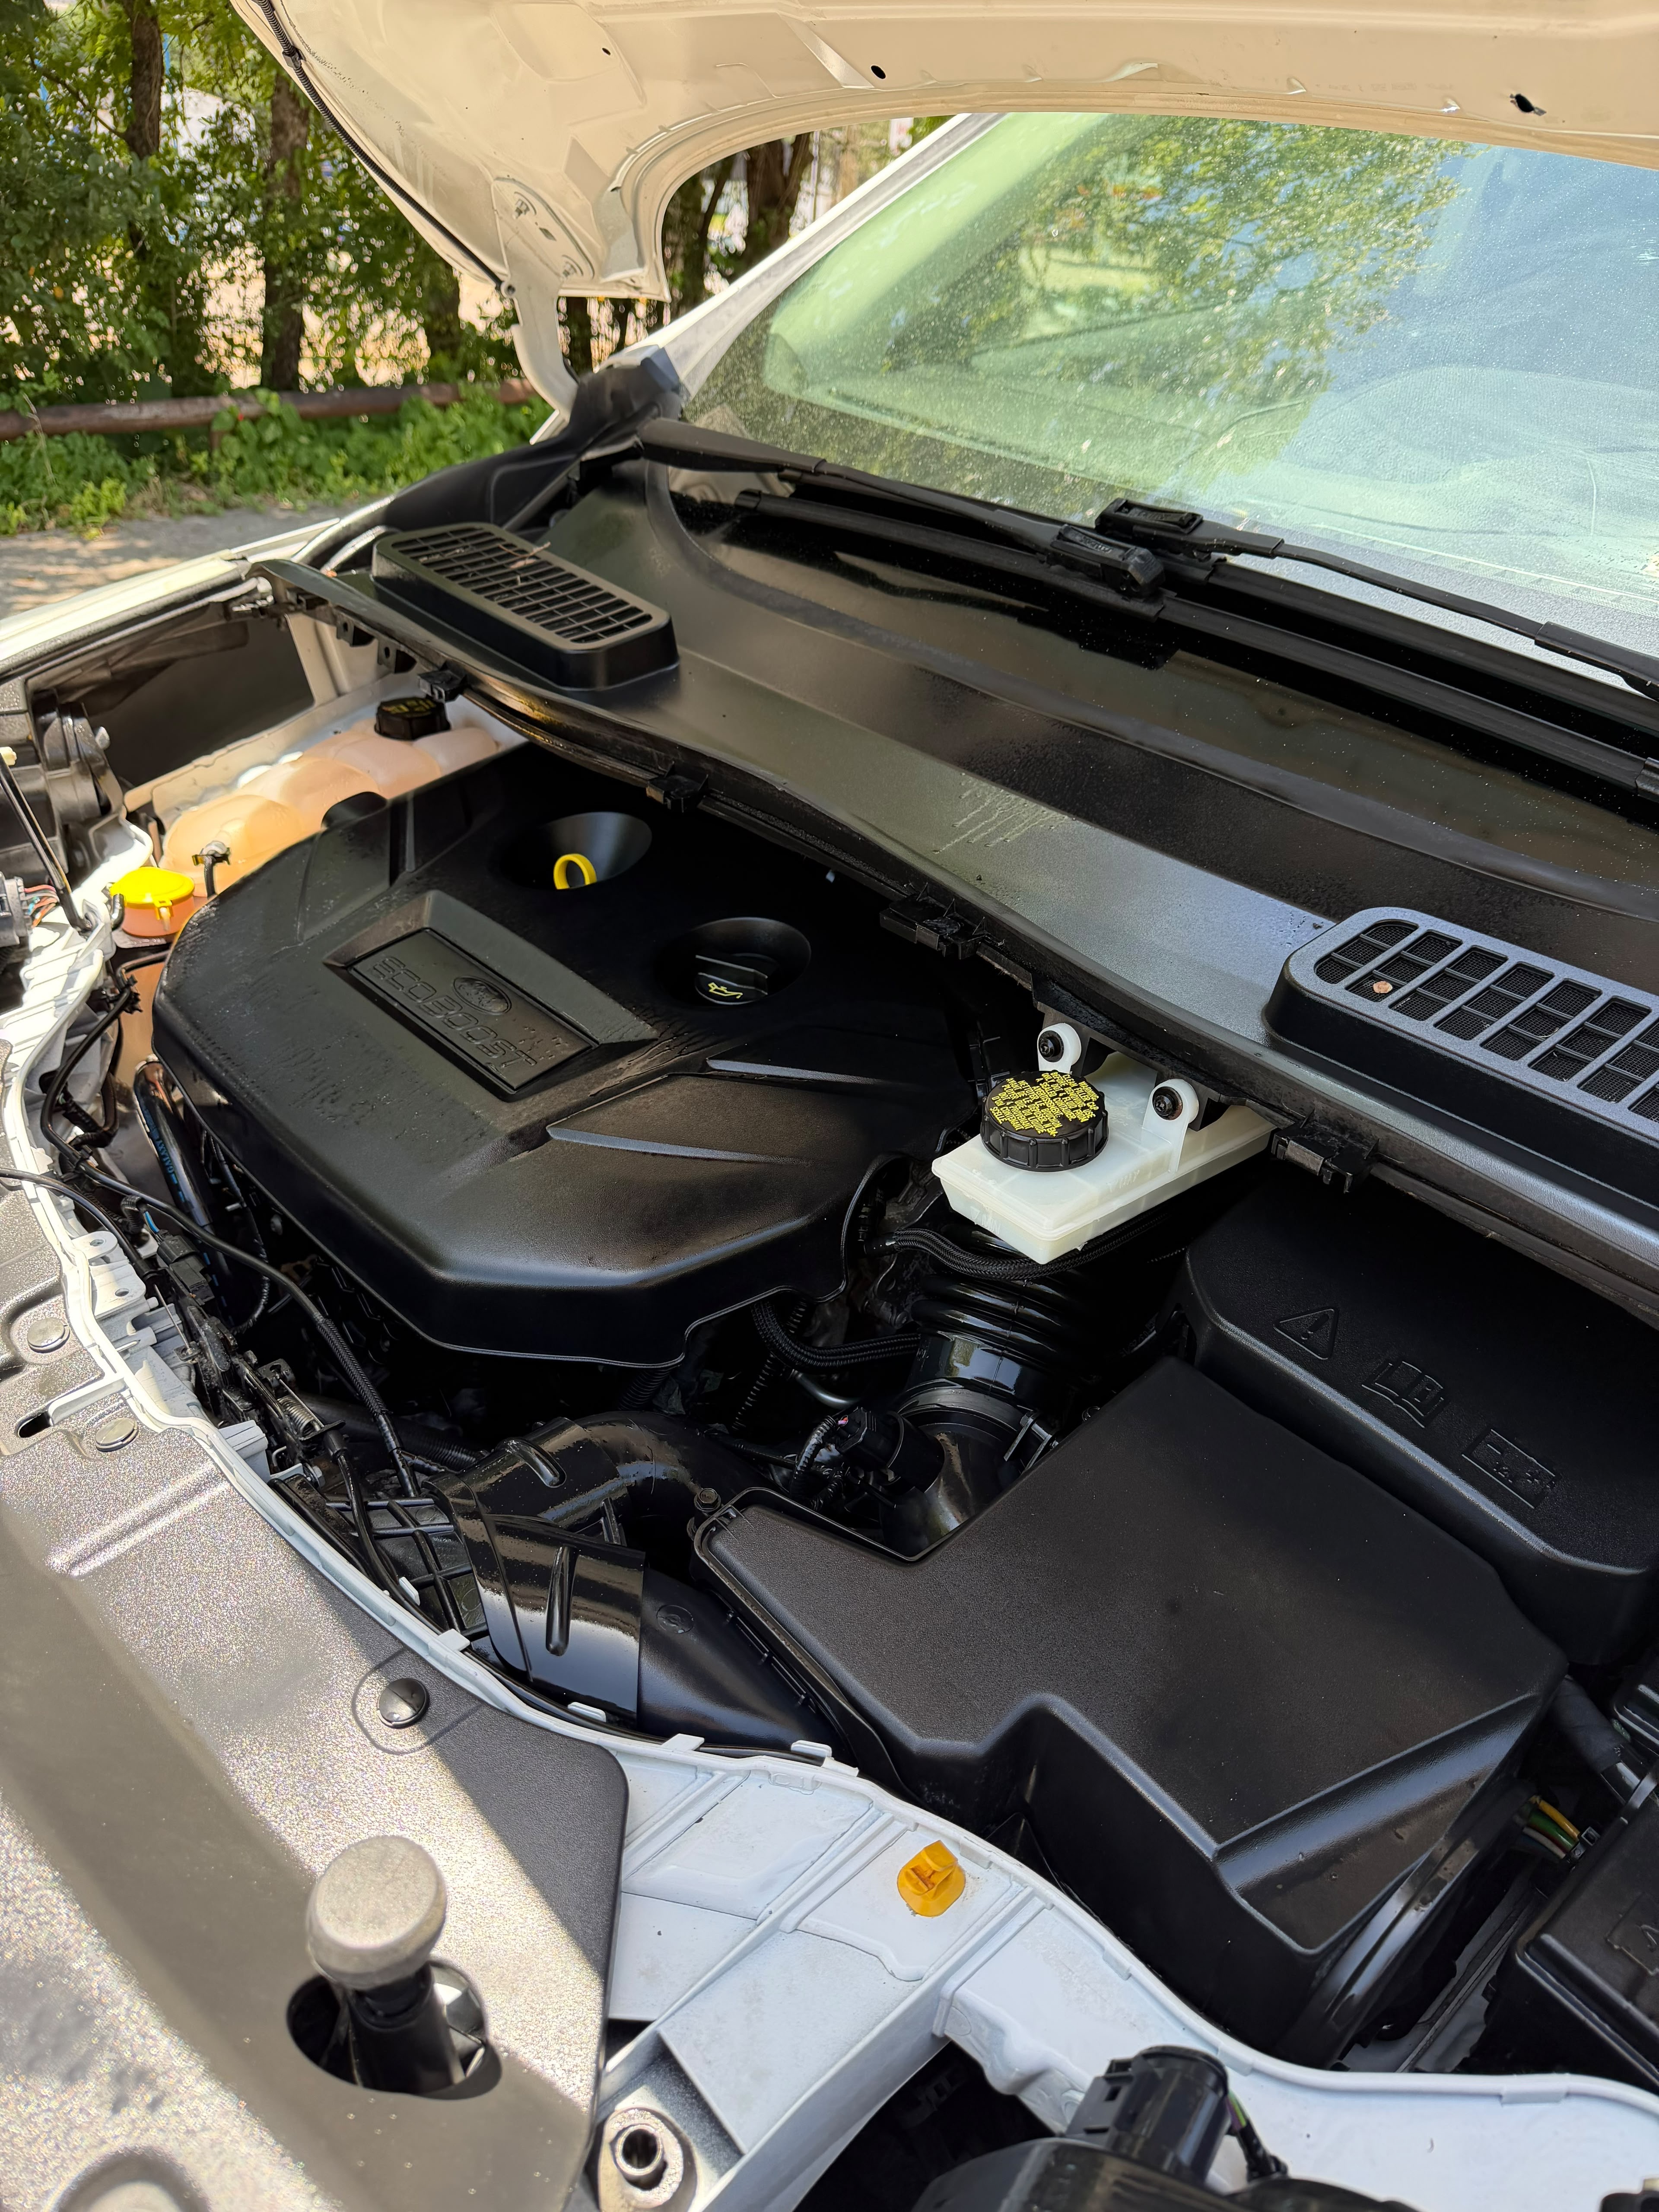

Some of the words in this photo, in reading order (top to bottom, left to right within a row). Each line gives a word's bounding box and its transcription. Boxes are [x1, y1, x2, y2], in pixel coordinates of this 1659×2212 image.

[372, 956, 538, 1068] ECOBOOST
[1006, 1078, 1022, 1091] AVANT
[1039, 1082, 1057, 1097] SEALED
[1041, 1073, 1056, 1083] ONLY
[1050, 1083, 1064, 1092] DOT
[1062, 1096, 1077, 1109] FLUID
[1072, 1109, 1089, 1122] FROM
[1050, 1071, 1069, 1087] BEFORE
[1082, 1109, 1095, 1119] USE
[1062, 1074, 1077, 1087] CLEAN
[1073, 1087, 1091, 1102] FILLER
[1086, 1101, 1098, 1110] CAP
[1078, 1081, 1099, 1101] WARNING:
[998, 1091, 1011, 1101] DOT
[1008, 1105, 1034, 1130] PROVENANT
[1000, 1106, 1026, 1131] CONTENANT
[1002, 1084, 1021, 1100] PLOYER
[1014, 1100, 1027, 1109] QUE
[1027, 1116, 1047, 1134] LIQUIDE
[1017, 1080, 1039, 1101] NETTOYER
[1040, 1107, 1062, 1128] BOUCHON
[156, 1139, 175, 1173] GALAXY
[981, 1214, 1001, 1235] MIN
